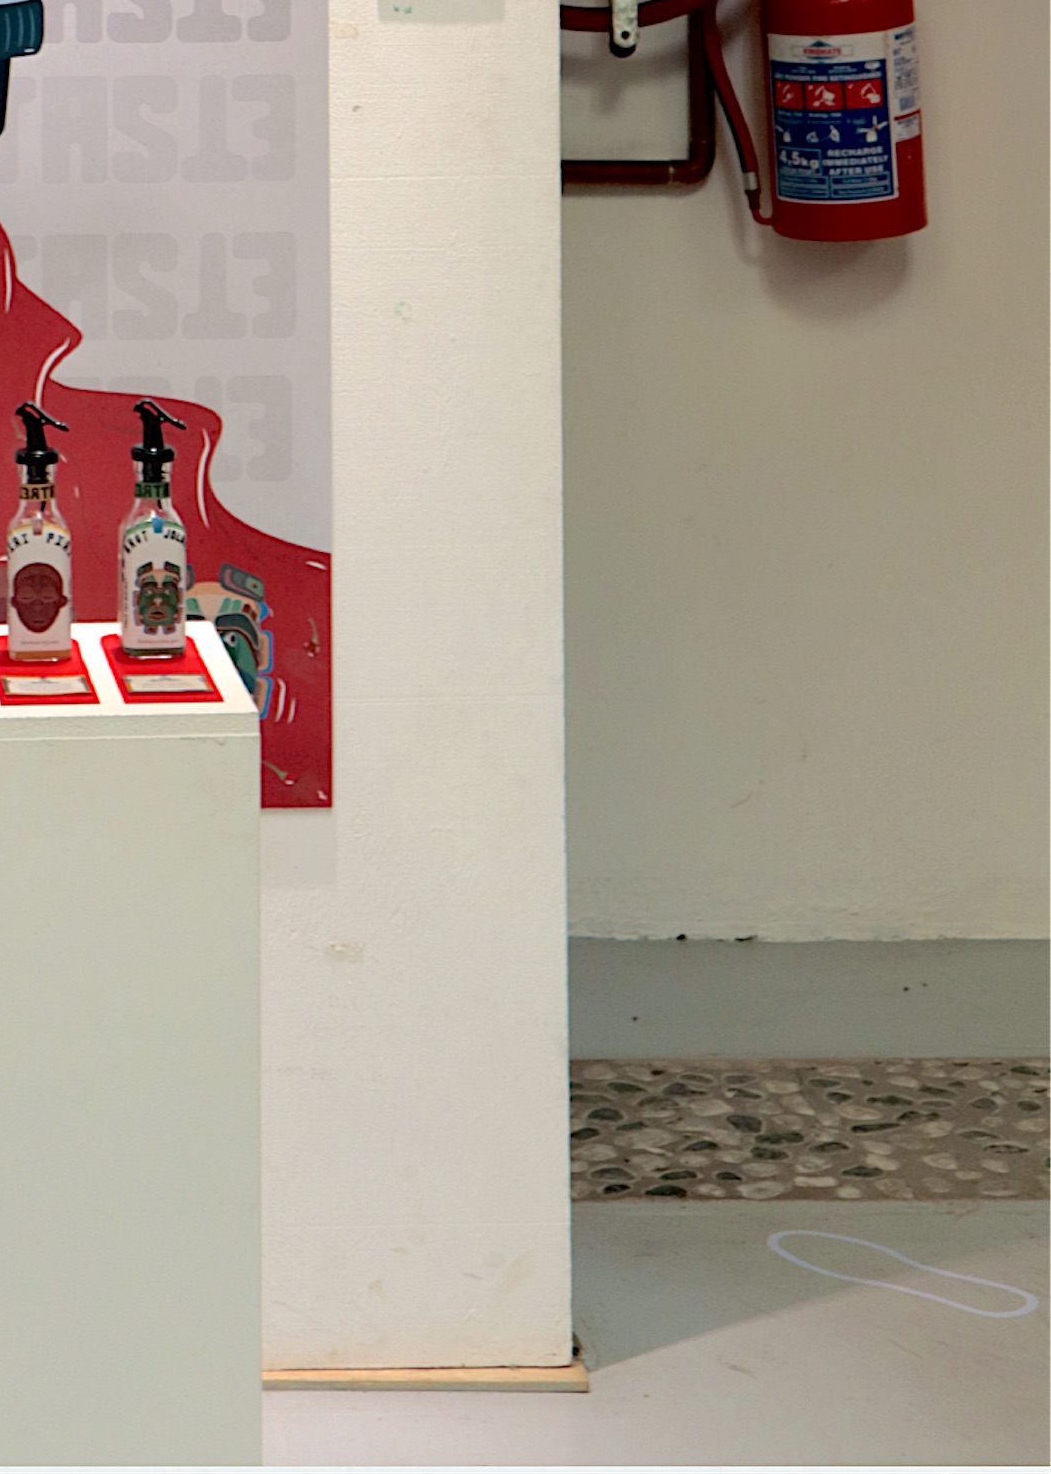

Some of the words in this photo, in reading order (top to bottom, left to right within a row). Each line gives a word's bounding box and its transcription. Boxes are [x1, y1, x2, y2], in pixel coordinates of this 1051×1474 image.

[827, 145, 884, 157] RECHARGE
[821, 154, 889, 167] IMMEDIATELY
[829, 166, 862, 175] AFTER
